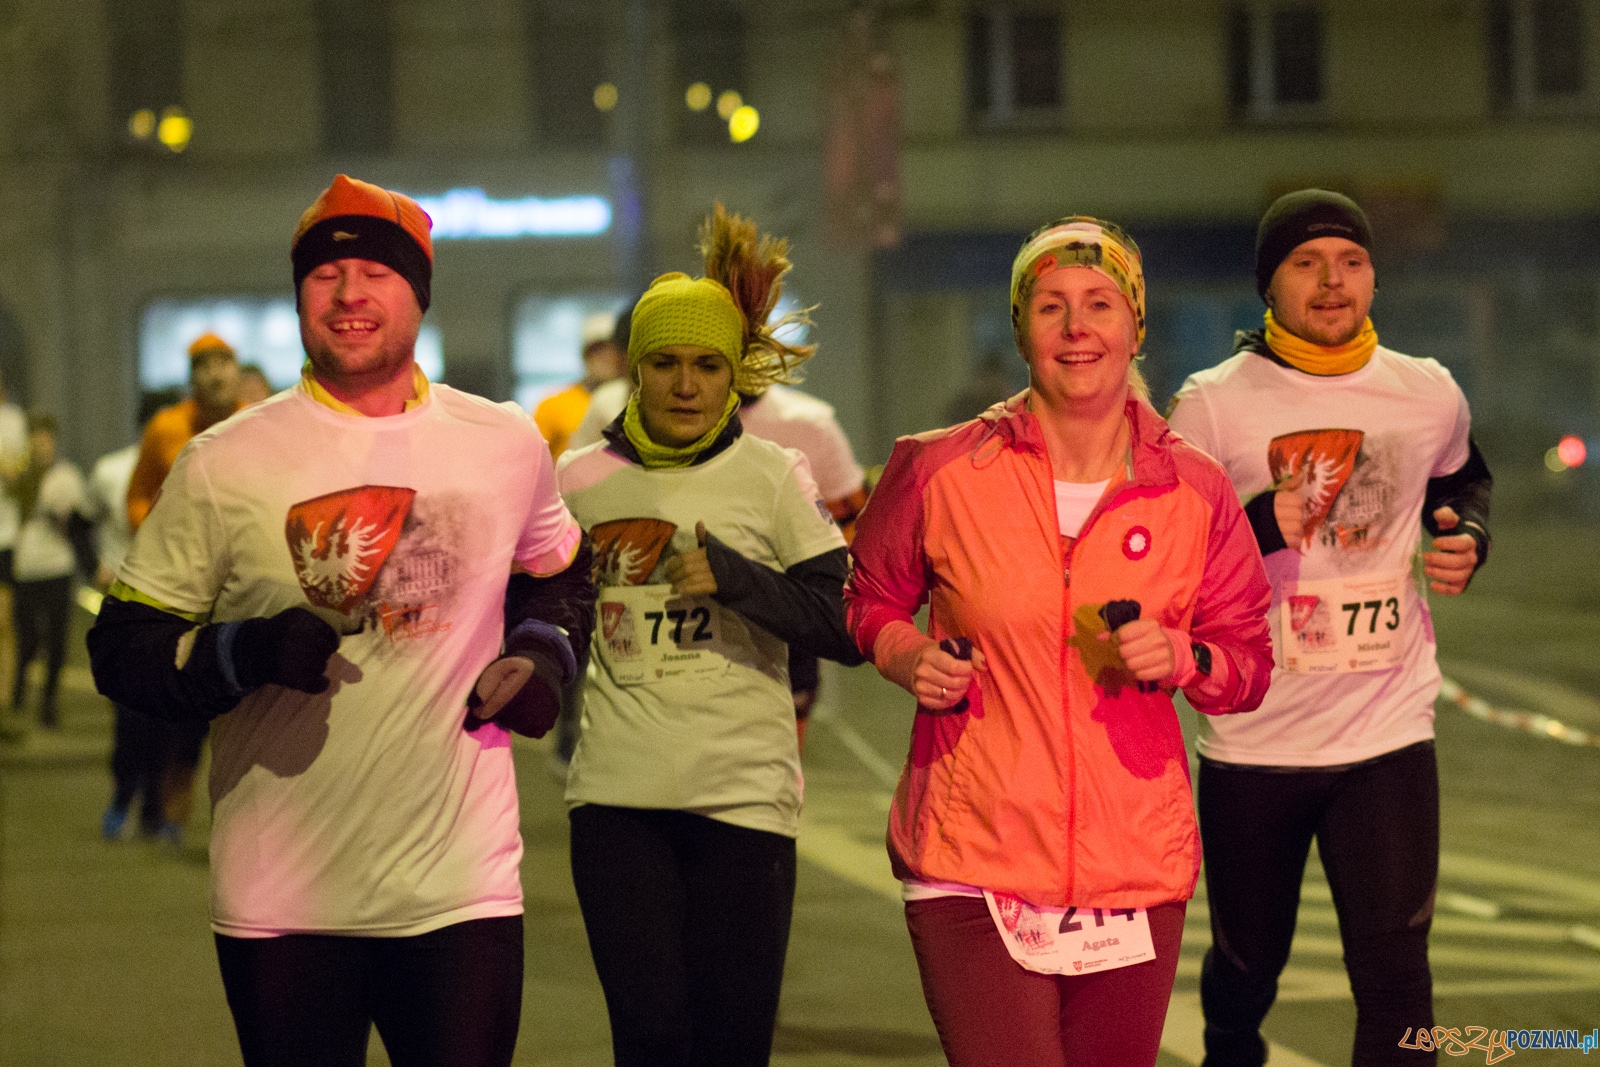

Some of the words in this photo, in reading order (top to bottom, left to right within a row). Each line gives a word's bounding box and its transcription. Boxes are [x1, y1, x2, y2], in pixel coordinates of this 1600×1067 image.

[644, 606, 713, 645] 772
[1341, 596, 1400, 636] 773
[1081, 937, 1121, 952] Agata
